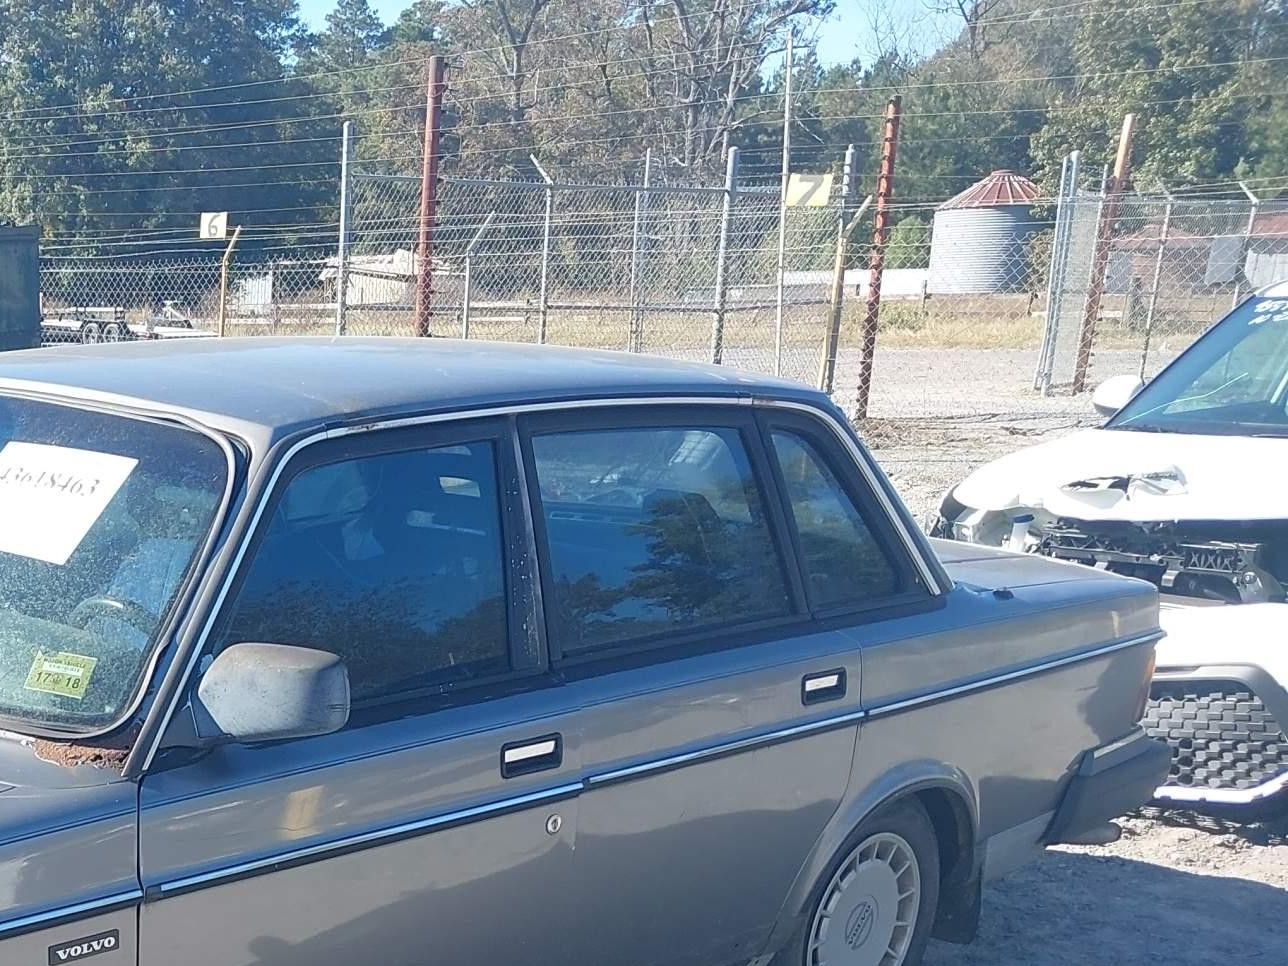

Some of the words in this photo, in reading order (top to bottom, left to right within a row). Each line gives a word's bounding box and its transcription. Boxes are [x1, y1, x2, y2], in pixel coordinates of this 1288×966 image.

[797, 174, 824, 206] 7
[208, 214, 221, 238] 6
[65, 676, 81, 689] 18
[56, 936, 116, 960] VOLVO
